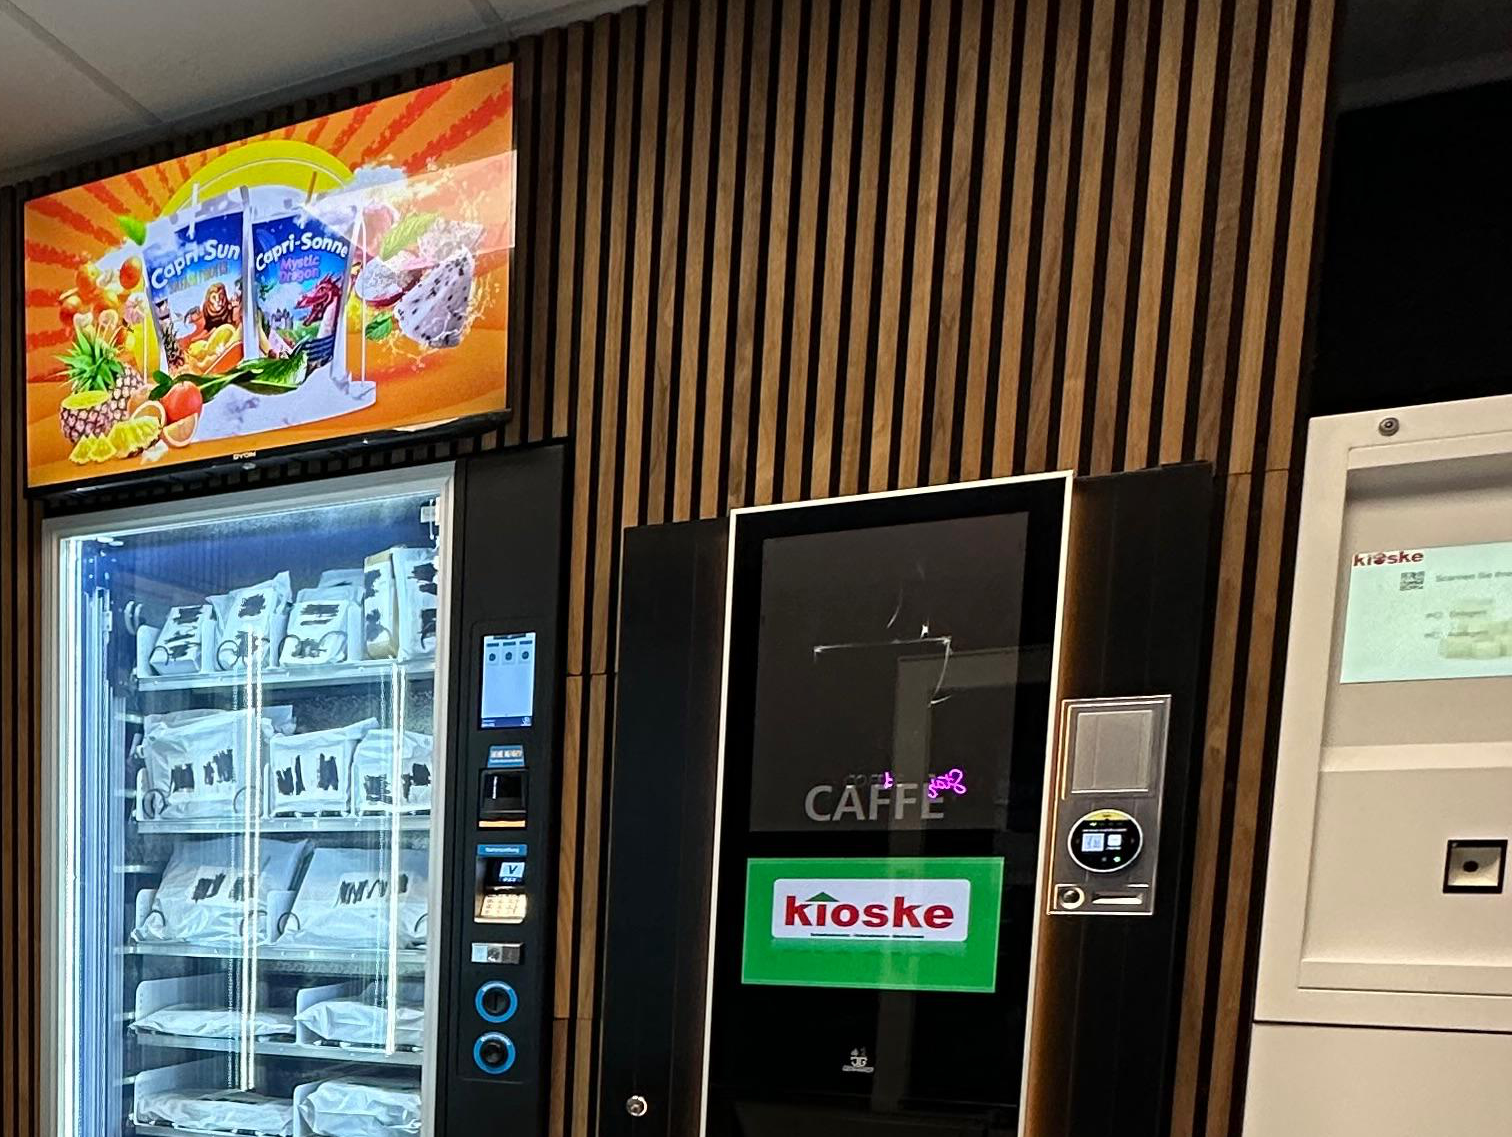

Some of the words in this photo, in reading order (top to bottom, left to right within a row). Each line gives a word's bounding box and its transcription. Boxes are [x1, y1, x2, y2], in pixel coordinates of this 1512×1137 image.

[151, 239, 241, 290] Capri-Sun
[256, 232, 349, 272] Capri-Sonne
[280, 254, 320, 271] Mystic
[280, 267, 320, 283] Dragon
[784, 895, 955, 929] kioske
